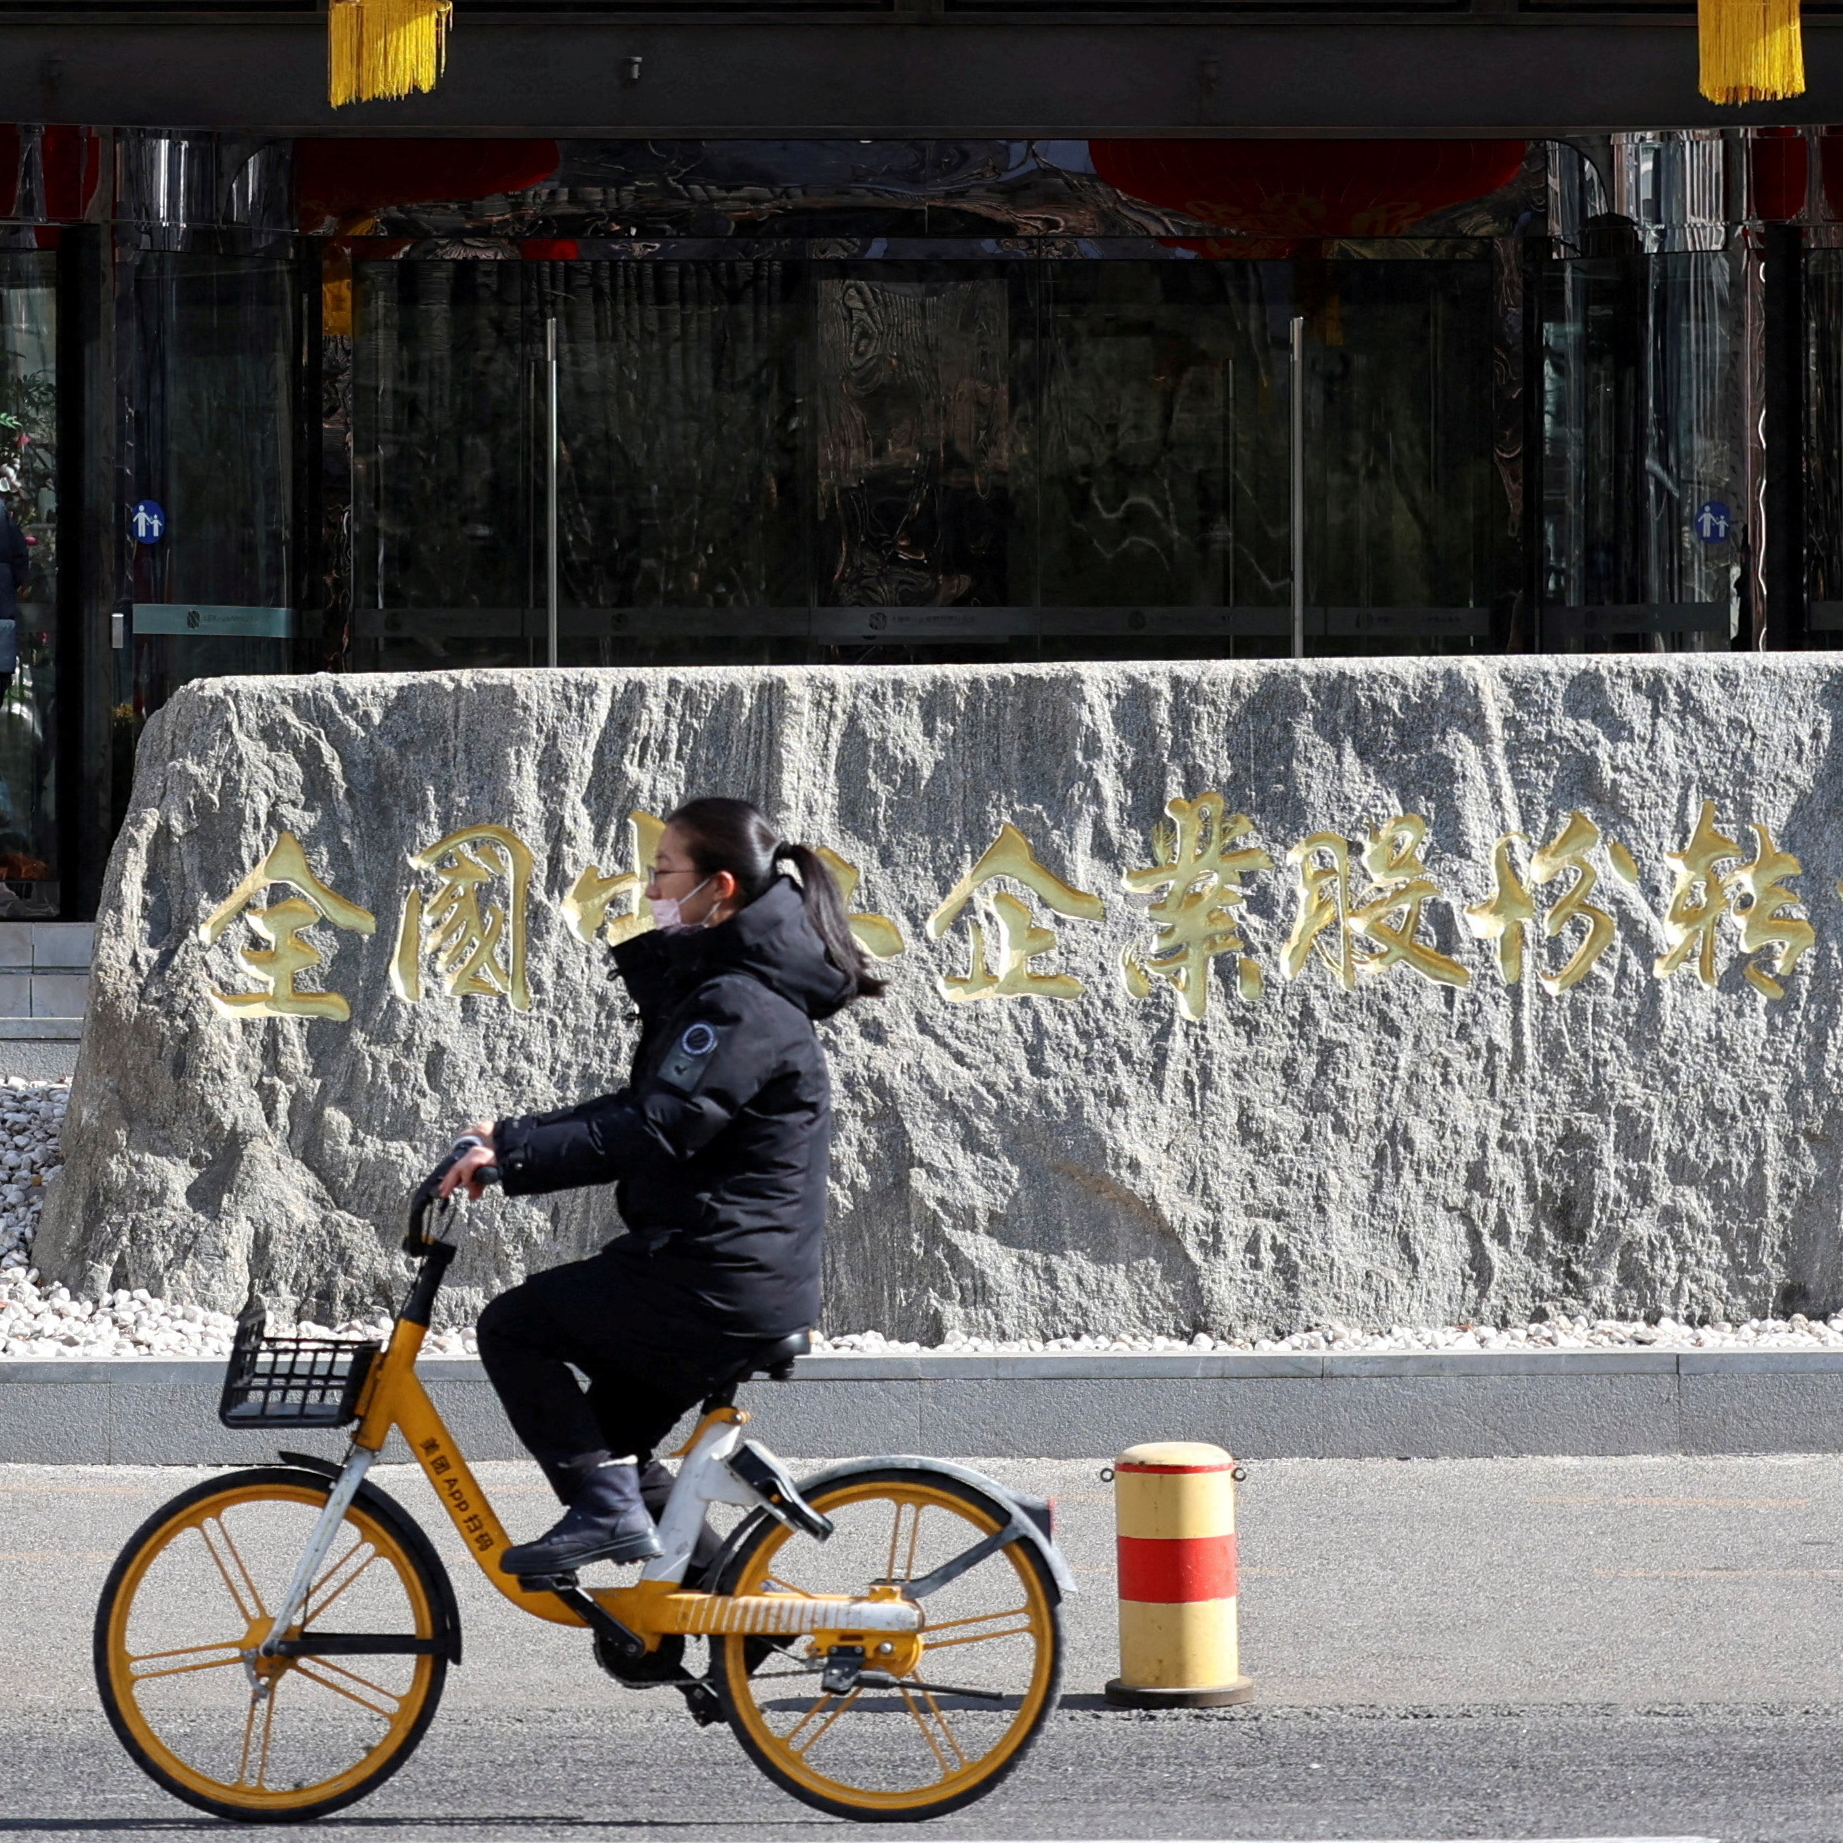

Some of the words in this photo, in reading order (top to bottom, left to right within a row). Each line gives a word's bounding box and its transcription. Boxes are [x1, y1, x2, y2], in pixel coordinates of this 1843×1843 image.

[420, 1437, 452, 1476] 美团
[443, 1477, 470, 1512] App
[463, 1514, 495, 1552] 扫码
